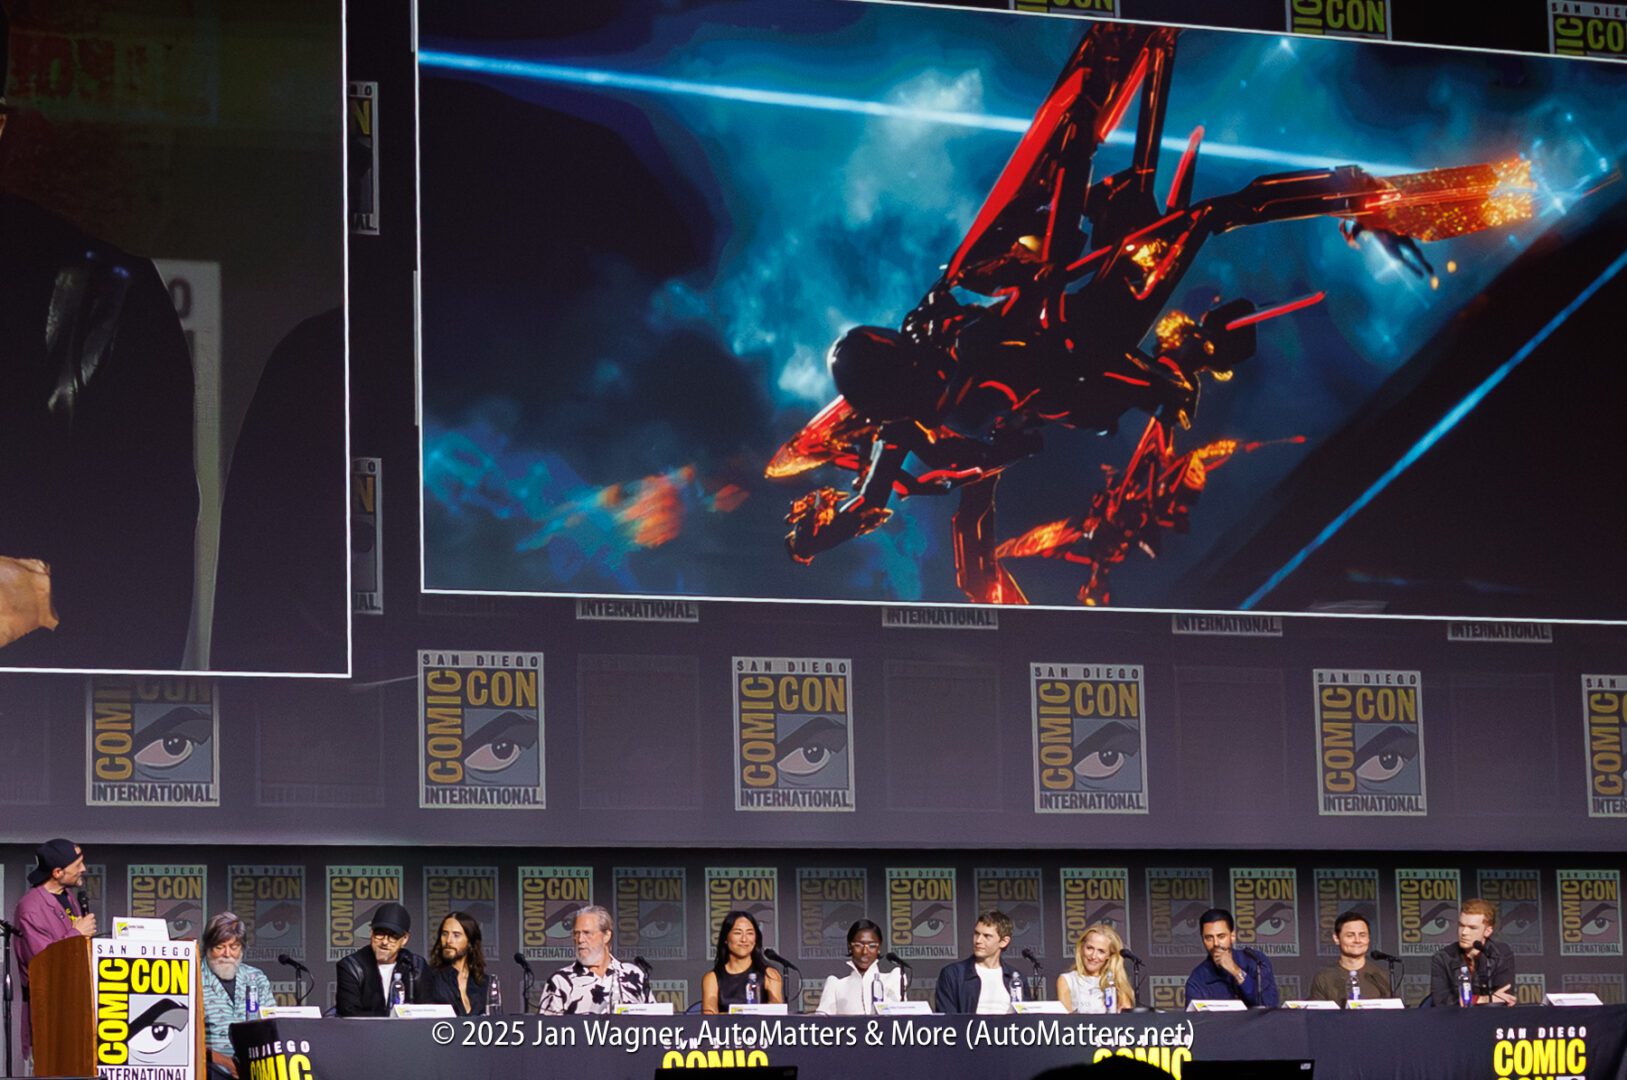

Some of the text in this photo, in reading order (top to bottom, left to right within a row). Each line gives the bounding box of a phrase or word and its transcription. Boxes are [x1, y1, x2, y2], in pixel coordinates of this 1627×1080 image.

[1326, 0, 1384, 32] CON
[1594, 6, 1627, 18] DIE
[1587, 19, 1627, 52] CO
[582, 600, 696, 618] INTERNATIONAL
[887, 608, 994, 625] INTERNATIONAL
[1177, 615, 1278, 632] INTERNATIONAL
[423, 654, 538, 667] SAN DIEGO
[737, 660, 846, 673] SAN DIEGO
[1034, 667, 1139, 679] SAN DIEGO
[1317, 672, 1417, 685] SAN DIEGO
[1586, 678, 1616, 688] SAN
[466, 670, 536, 707] CON
[778, 676, 845, 712] CON
[1075, 682, 1138, 717] CON
[1356, 688, 1416, 722] CON
[427, 670, 463, 783] COMIC
[741, 676, 777, 787] COMIC
[1039, 681, 1074, 790] COMIC
[1321, 687, 1355, 793] COMIC
[1590, 692, 1623, 795] COMIC
[92, 784, 215, 802] INTERNATIONAL
[425, 787, 540, 804] INTERNATIONAL
[741, 790, 850, 808] INTERNATIONAL
[1040, 793, 1144, 809] INTERNATIONAL
[1324, 796, 1423, 812] INTERNATIONAL
[164, 867, 203, 875] DIEGO
[553, 869, 589, 877] DIEGO
[134, 878, 156, 916] MIC
[158, 877, 202, 899] CON
[259, 878, 300, 899] CON
[356, 878, 398, 899] CON
[452, 879, 493, 899] CON
[548, 879, 588, 900] CON
[642, 879, 681, 900] CON
[734, 879, 773, 900] CON
[824, 880, 863, 900] CON
[913, 880, 952, 900] CON
[1001, 880, 1038, 899] CON
[1087, 880, 1124, 899] CON
[1256, 880, 1293, 899] CON
[1339, 880, 1374, 899] CON
[1421, 880, 1457, 900] CON
[1502, 881, 1537, 900] CON
[1582, 881, 1616, 900] CON
[332, 878, 353, 946] COMIC
[524, 879, 546, 946] COMIC
[619, 879, 640, 946] COMIC
[802, 880, 822, 945] COMIC
[891, 880, 912, 945] COMIC
[1235, 880, 1256, 942] COMIC
[1401, 880, 1421, 942] COMIC
[1562, 881, 1581, 942] COMIC
[97, 944, 190, 955] SAN DIEGO
[524, 948, 574, 958] INTERNATIO
[130, 959, 189, 994] CON
[1518, 985, 1541, 1004] ON
[97, 958, 130, 1065] COMIC
[1496, 1026, 1587, 1040] SAN DIEGO
[1494, 1038, 1587, 1076] COMIC
